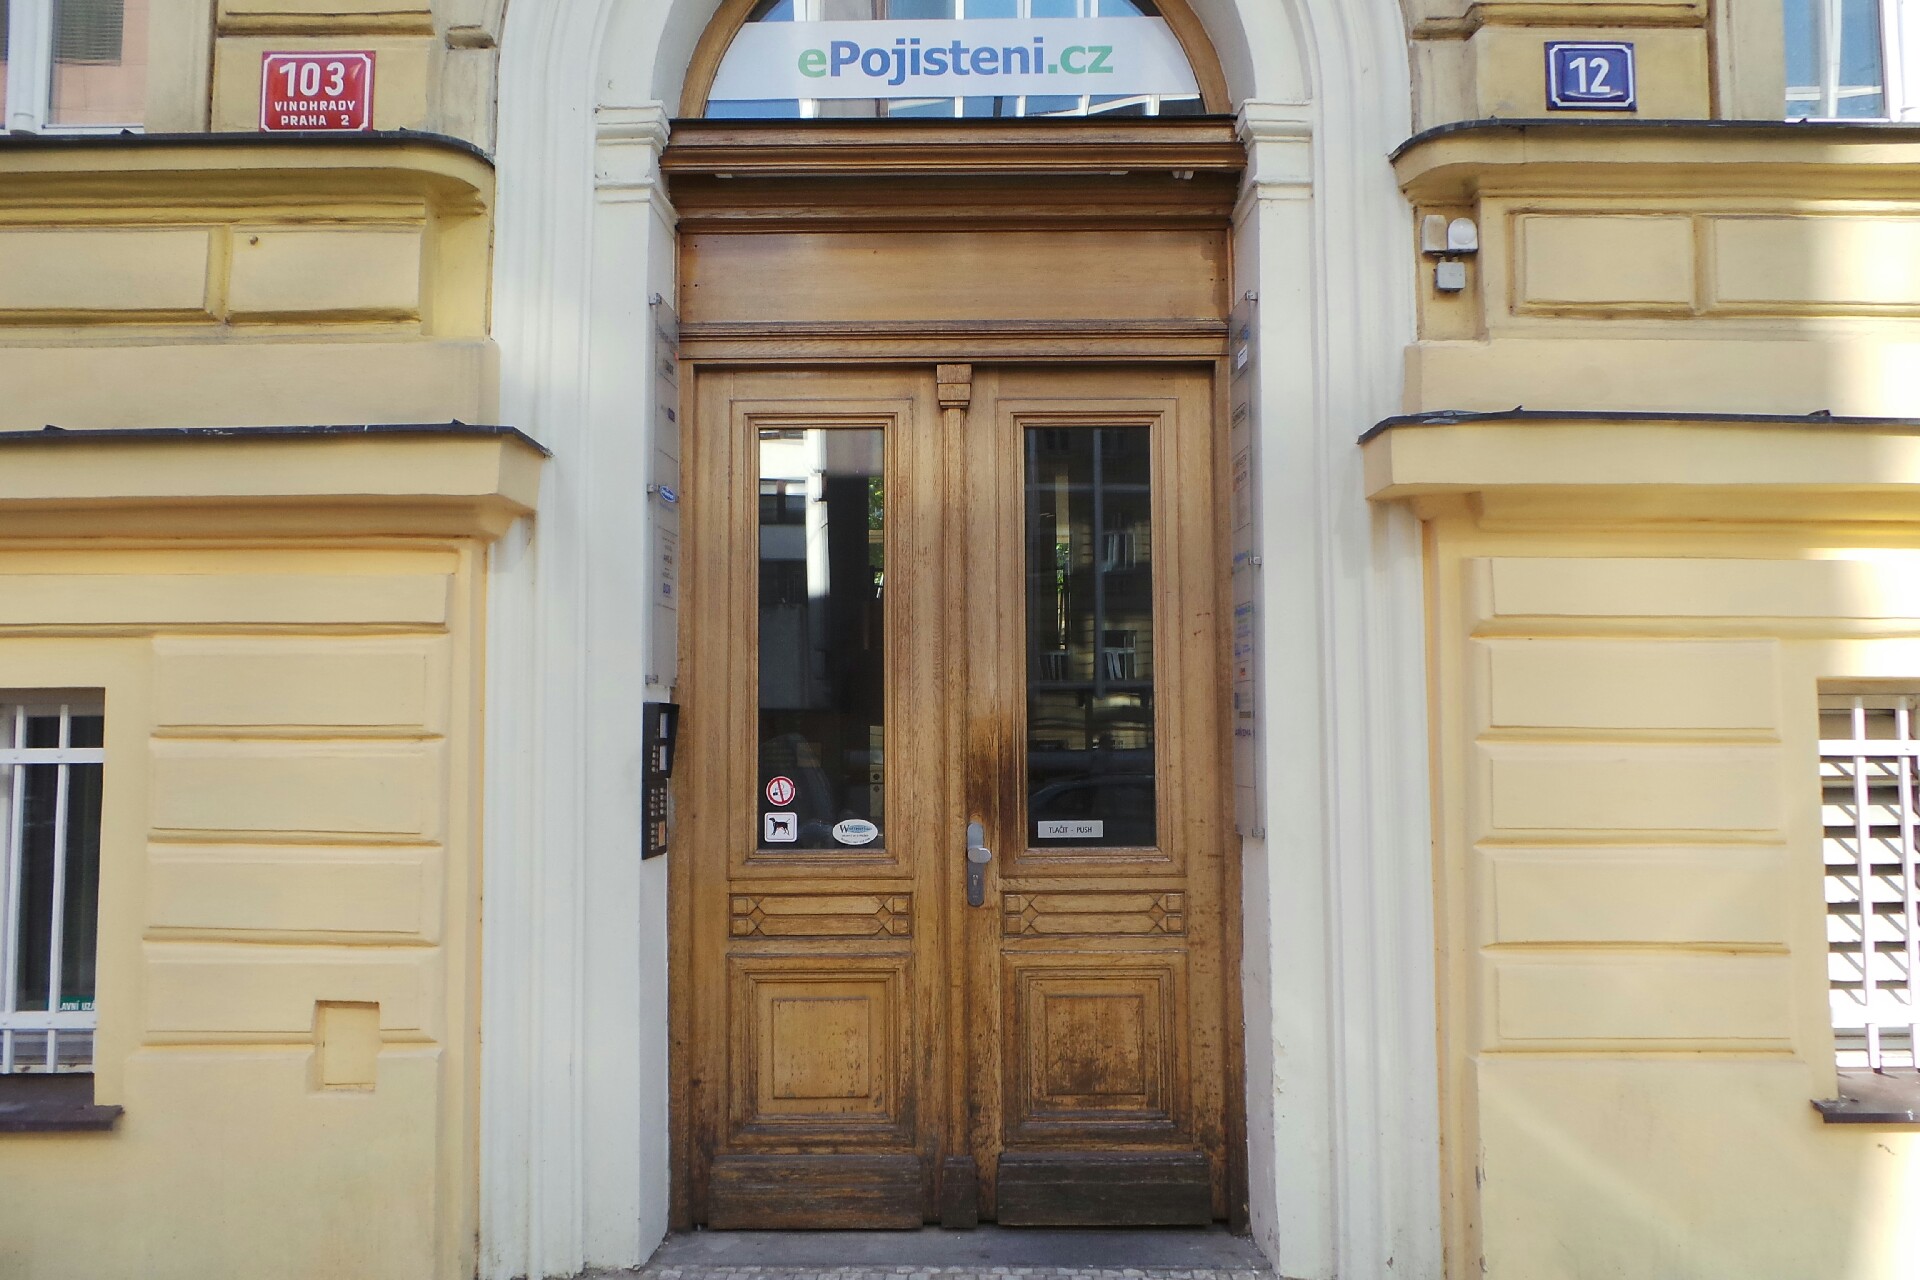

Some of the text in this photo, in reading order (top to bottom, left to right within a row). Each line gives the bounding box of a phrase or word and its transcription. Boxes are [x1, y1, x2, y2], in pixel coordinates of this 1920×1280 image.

[797, 37, 1114, 86] ePojisteni.cz
[279, 61, 346, 97] 103
[1569, 57, 1611, 93] 12
[274, 100, 356, 112] VINOHRADY
[281, 114, 350, 126] PRAHA 2
[1048, 825, 1069, 834] TLAČIT
[1076, 826, 1093, 834] PUSH
